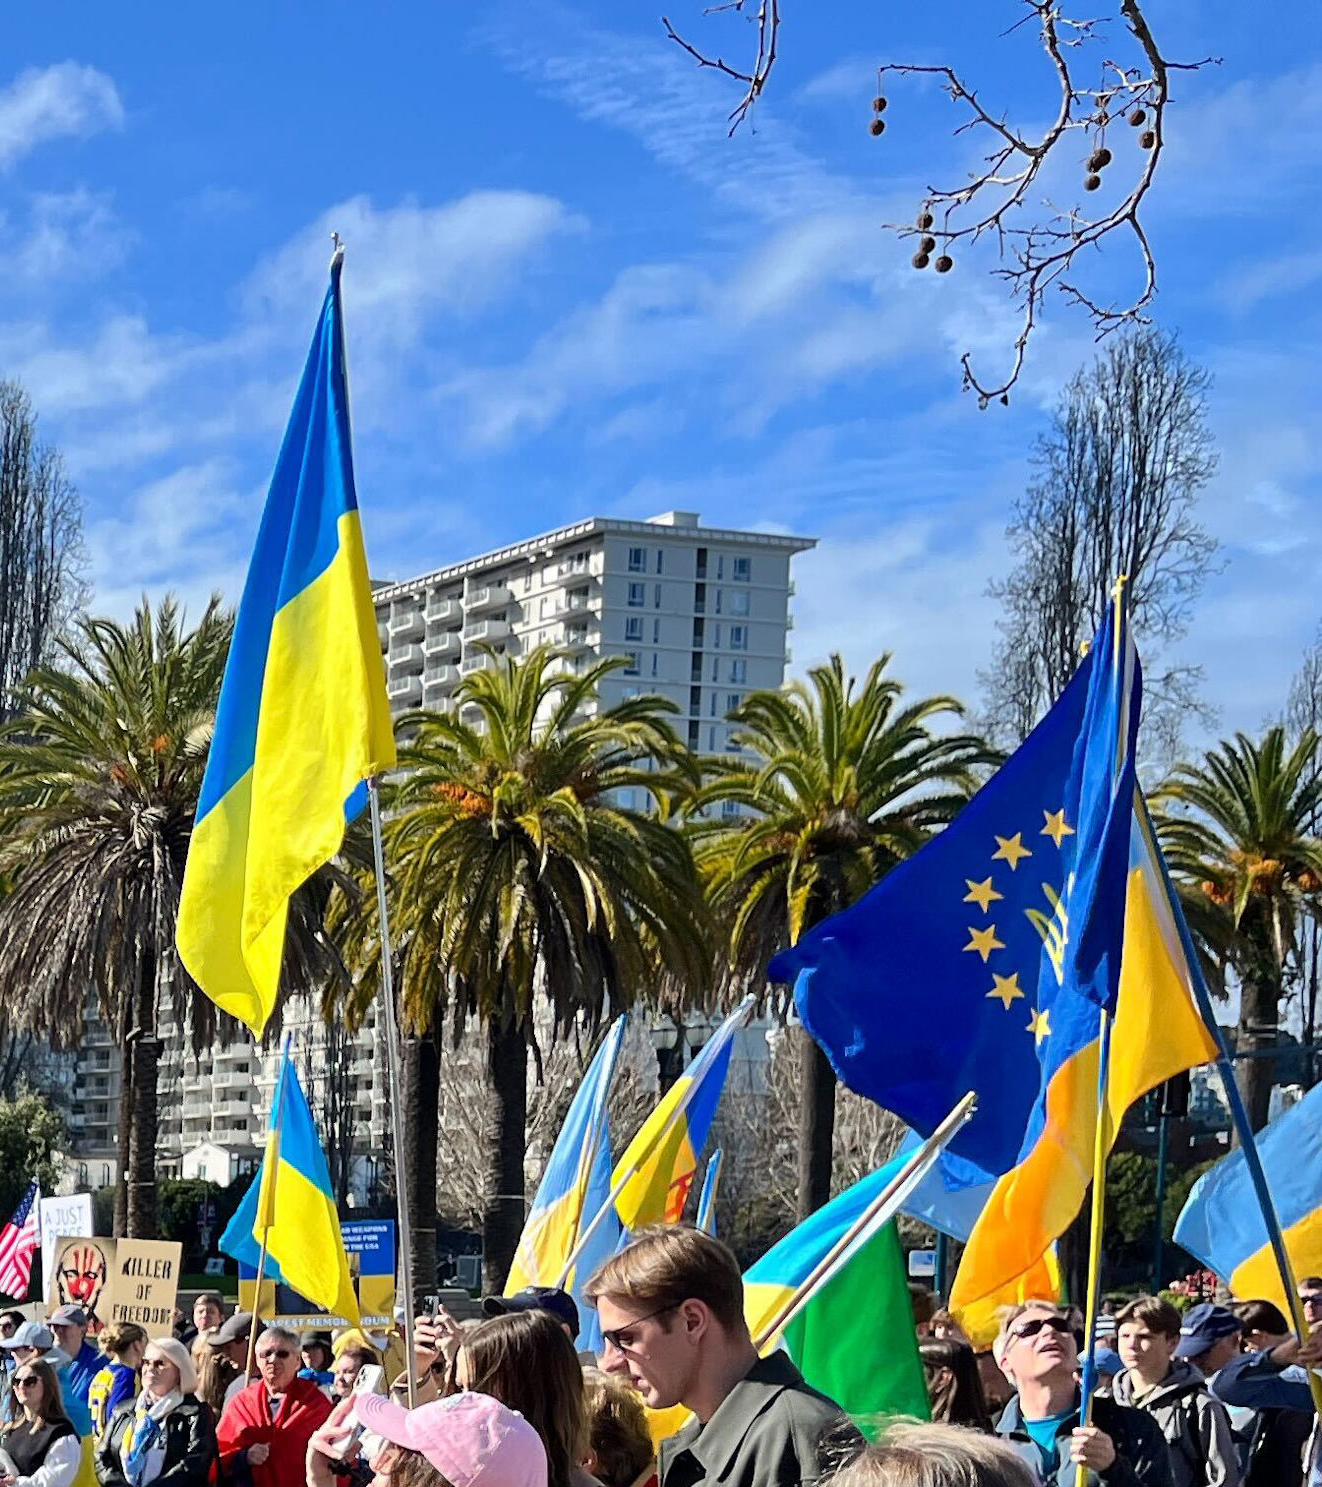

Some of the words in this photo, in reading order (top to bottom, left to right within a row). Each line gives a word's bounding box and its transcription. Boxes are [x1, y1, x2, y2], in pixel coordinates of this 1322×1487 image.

[56, 1205, 84, 1226] JUST
[121, 1256, 173, 1280] KILLER
[135, 1283, 153, 1301] OF
[112, 1303, 171, 1325] FREEDOM
